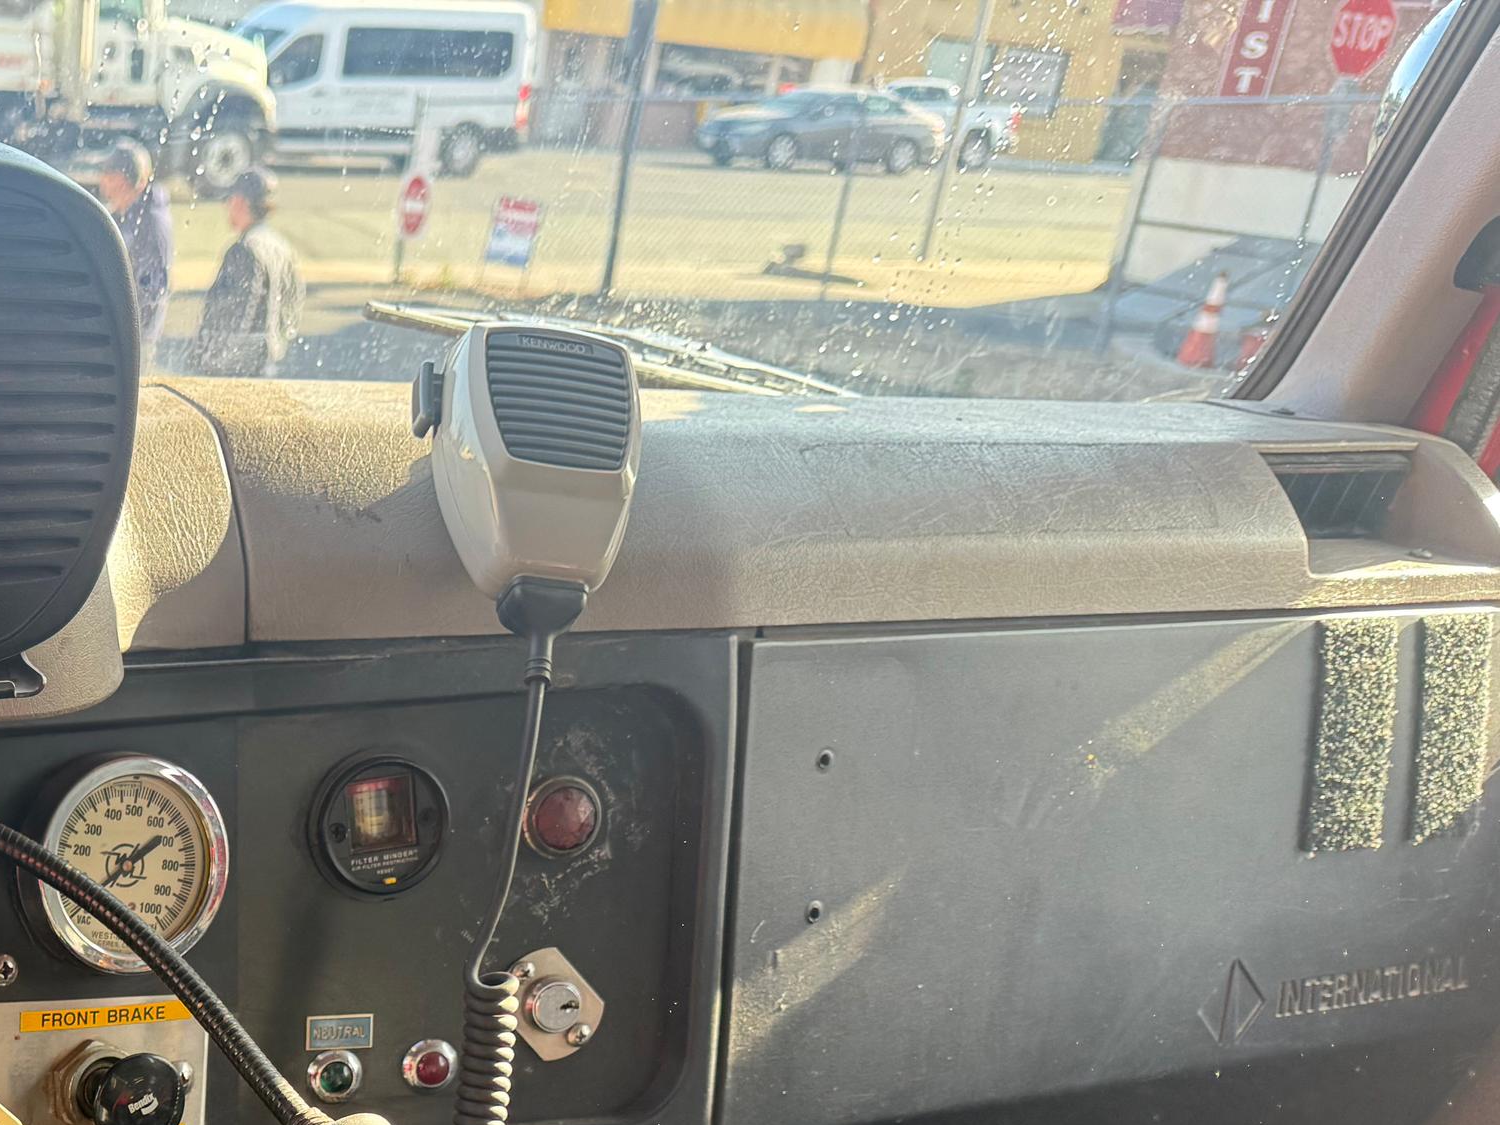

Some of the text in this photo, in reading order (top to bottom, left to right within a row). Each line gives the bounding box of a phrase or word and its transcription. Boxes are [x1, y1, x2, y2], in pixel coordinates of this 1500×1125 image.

[1333, 13, 1392, 50] STOP
[521, 337, 585, 354] KENWOOD
[104, 808, 122, 821] 400
[125, 804, 143, 817] 500
[147, 816, 164, 829] 600
[84, 823, 103, 836] 300
[73, 844, 91, 857] 200
[162, 859, 179, 872] 800
[351, 856, 379, 866] FILTER
[154, 884, 171, 897] 900
[139, 902, 162, 915] 1000
[76, 914, 92, 925] VAC
[1275, 957, 1469, 1018] INTERNATIONAL
[41, 1006, 165, 1029] FRONT BRAKE
[313, 1024, 365, 1040] NEUTRAL
[128, 1092, 156, 1114] Bendix
